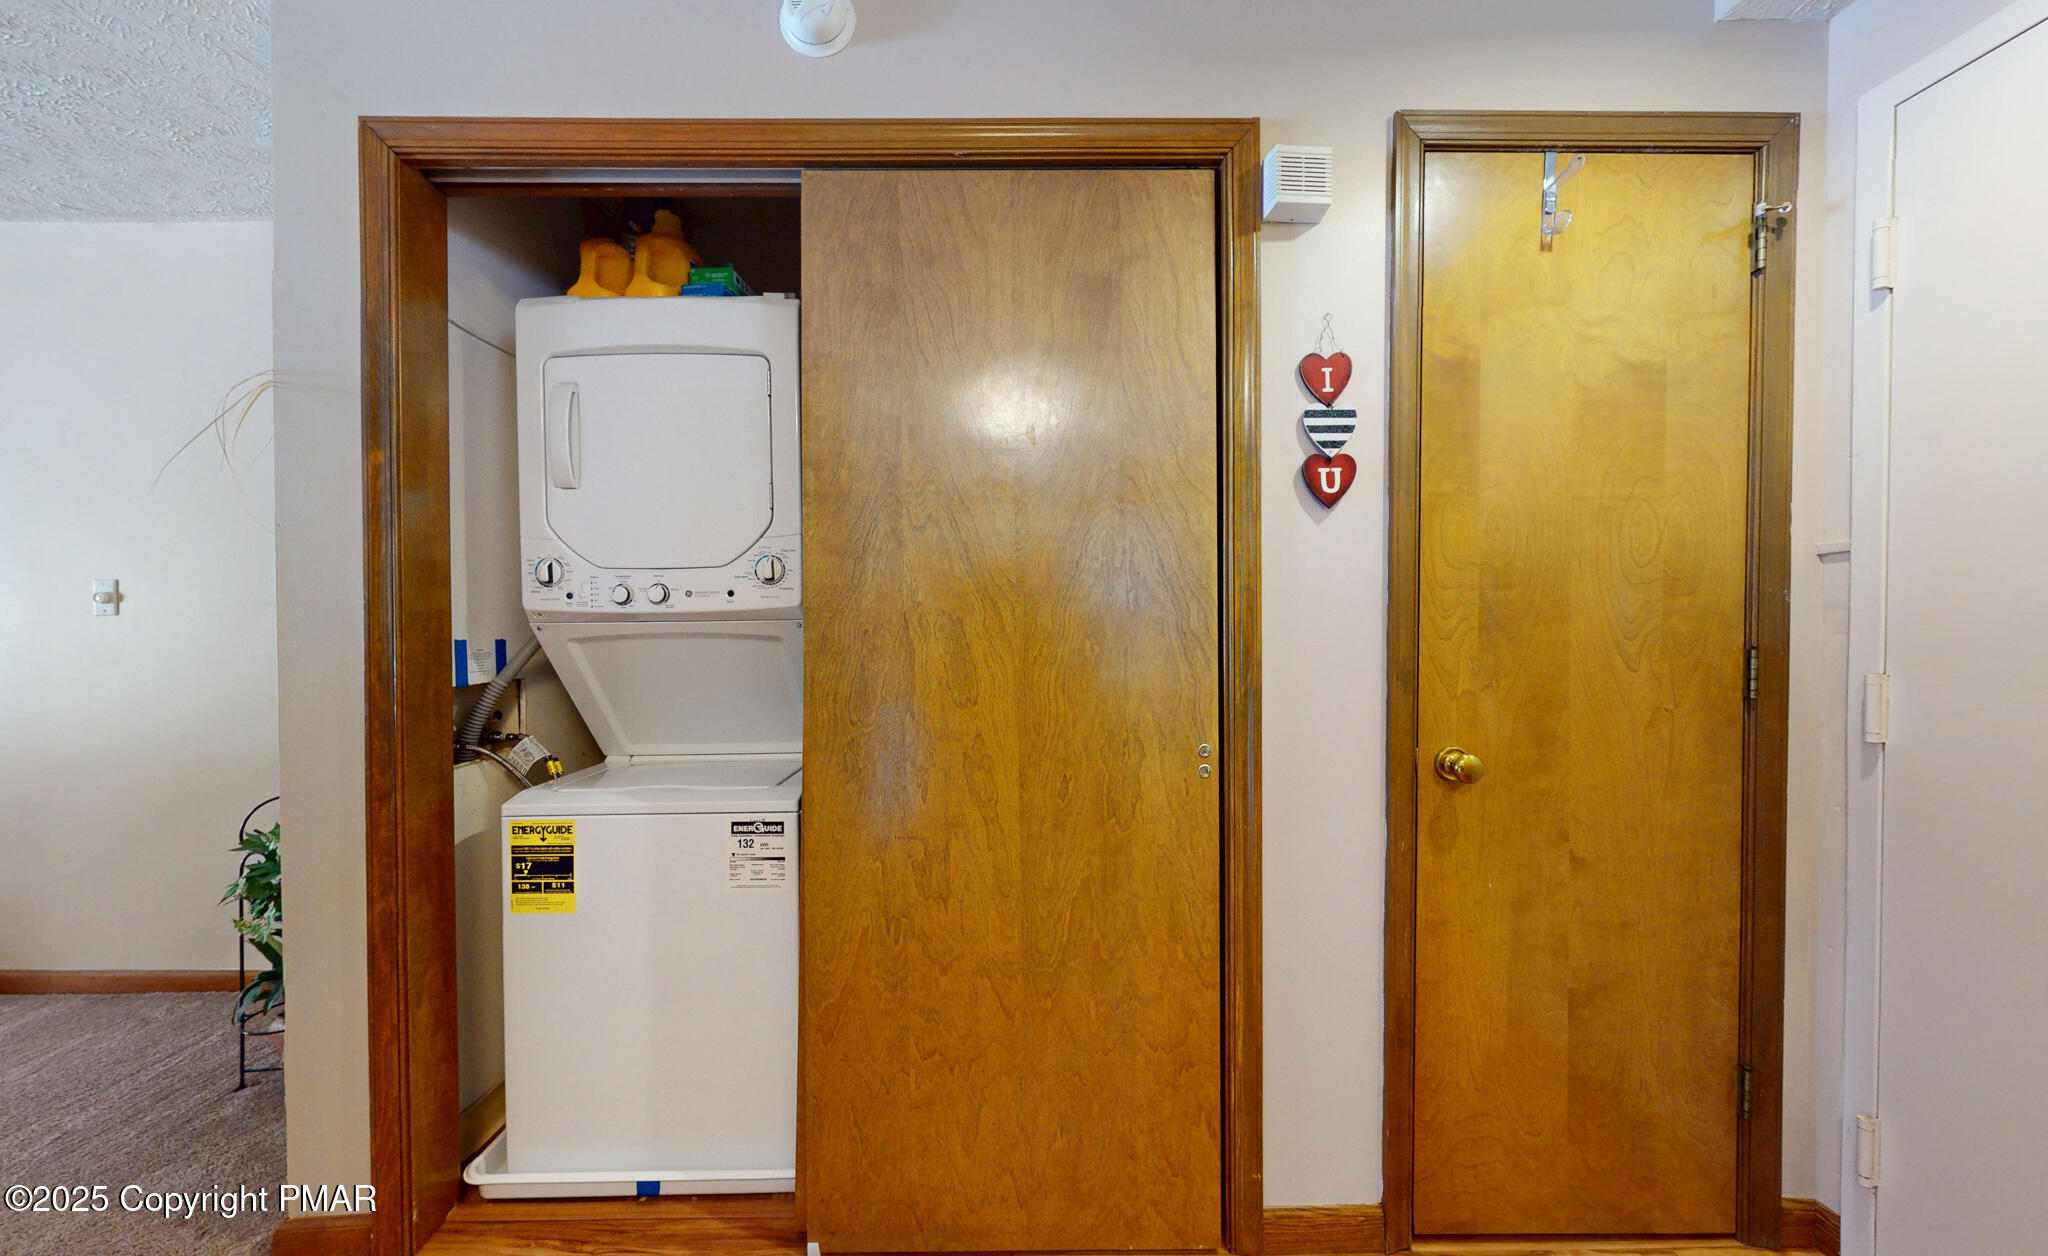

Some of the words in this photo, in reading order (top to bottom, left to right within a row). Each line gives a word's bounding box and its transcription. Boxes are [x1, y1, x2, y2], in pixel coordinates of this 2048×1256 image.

[1321, 367, 1334, 393] I
[1317, 467, 1342, 494] U
[512, 825, 573, 835] ENERGYGUIDE
[733, 822, 783, 833] ENERGUIDE
[737, 838, 755, 849] 132
